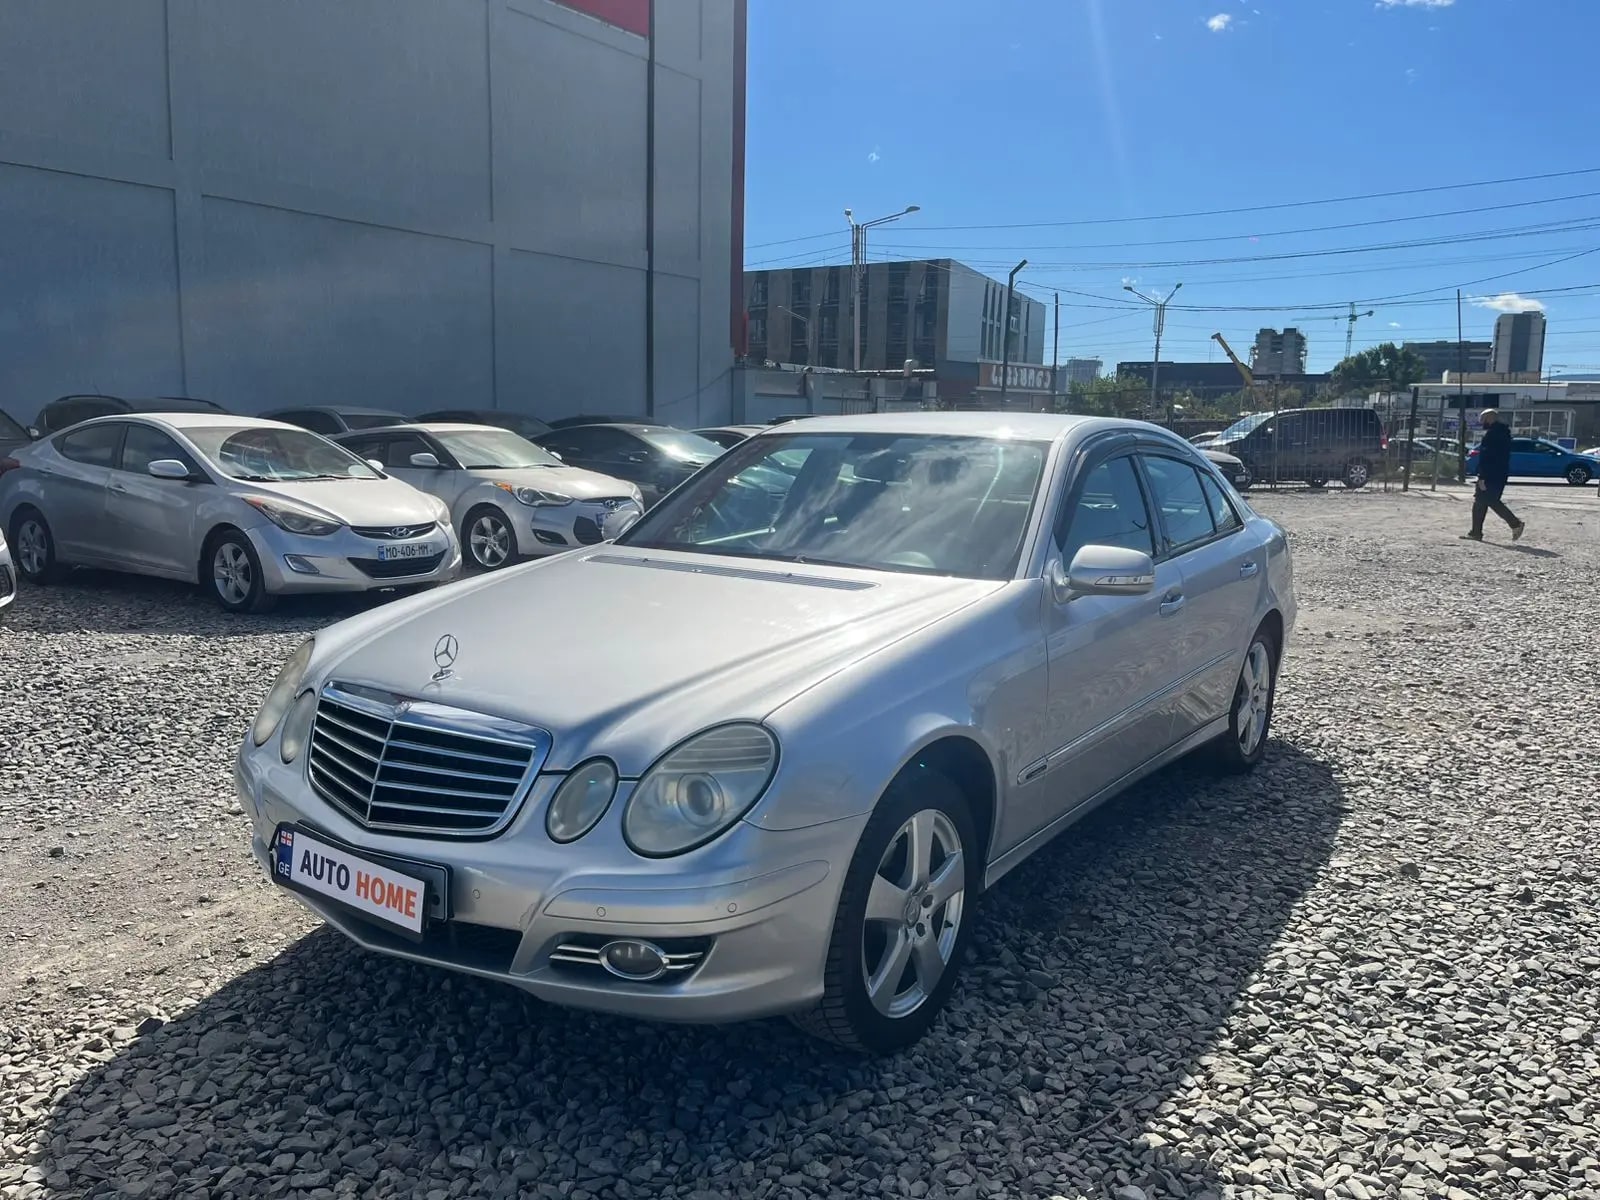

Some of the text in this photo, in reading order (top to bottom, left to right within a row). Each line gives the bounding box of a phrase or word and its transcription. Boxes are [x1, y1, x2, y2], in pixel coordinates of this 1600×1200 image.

[278, 861, 290, 877] GE
[300, 849, 418, 919] AUTO HOME
